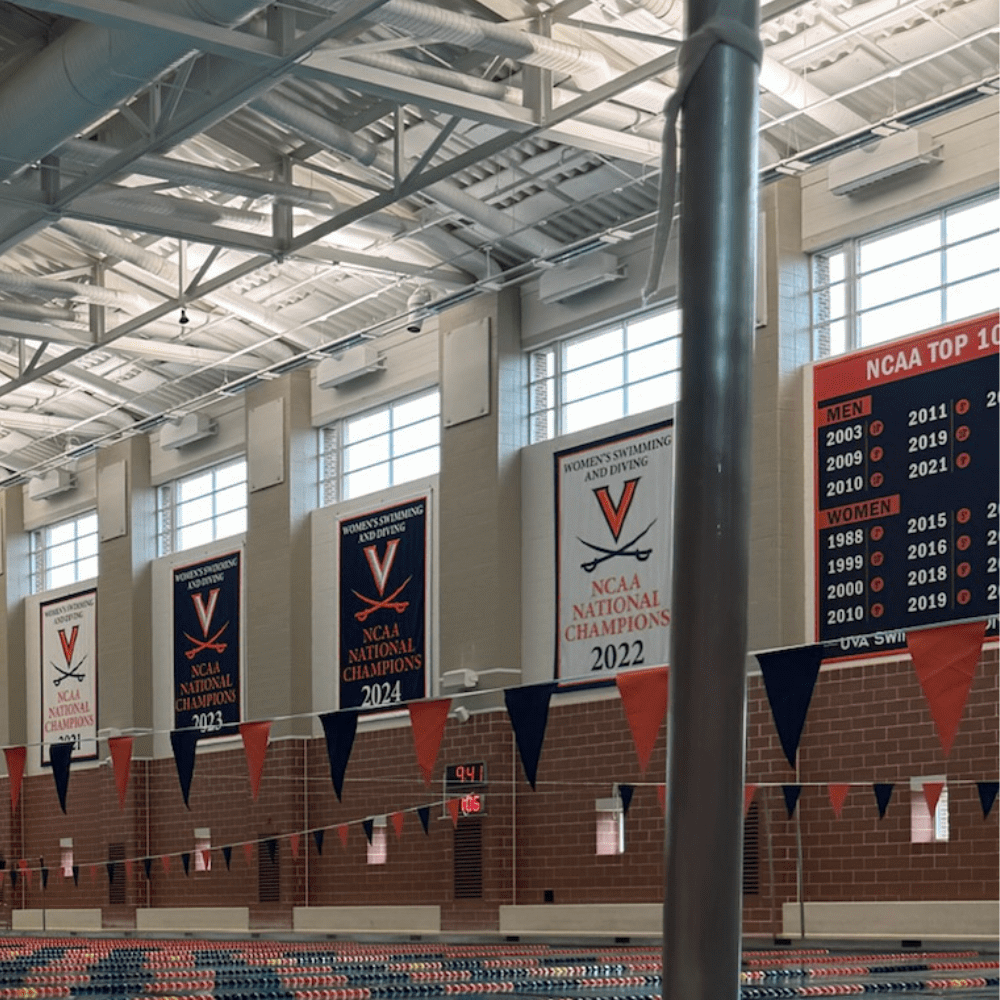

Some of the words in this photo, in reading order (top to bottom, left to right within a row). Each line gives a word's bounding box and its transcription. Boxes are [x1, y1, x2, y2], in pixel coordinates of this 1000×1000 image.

[867, 347, 922, 381] NCAA
[927, 334, 968, 363] TOP
[826, 400, 863, 422] MEN
[908, 403, 947, 427] 2011
[826, 424, 863, 447] 2003
[908, 430, 948, 453] 2019
[613, 435, 672, 460] SWIMMING
[584, 466, 608, 483] AND
[609, 455, 649, 476] DIVING
[826, 450, 863, 472] 2009
[908, 456, 948, 479] 2021
[826, 475, 864, 497] 2010
[827, 499, 891, 525] WOMEN
[907, 512, 947, 534] 2015
[377, 521, 406, 539] DIVING
[827, 528, 864, 550] 1988
[907, 539, 947, 560] 2016
[827, 554, 864, 575] 1999
[591, 573, 641, 597] NCAA
[907, 565, 947, 587] 2018
[827, 580, 864, 600] 2000
[573, 590, 660, 621] NATIONAL
[907, 592, 947, 613] 2019
[564, 609, 671, 642] CHAMPIONS
[827, 605, 864, 625] 2010
[363, 622, 400, 644] NCAA
[840, 636, 870, 651] UVA
[348, 637, 415, 664] NATIONAL
[590, 639, 645, 671] 2022
[191, 660, 220, 679] NCAA
[343, 654, 422, 682] CHAMPIONS
[57, 688, 80, 703] NCAA
[180, 673, 233, 696] NATIONAL
[361, 680, 402, 707] 2024
[48, 701, 90, 718] NATIONAL
[175, 688, 236, 712] CHAMPIONS
[45, 715, 94, 733] CHAMPIONS
[191, 709, 223, 733] 2023
